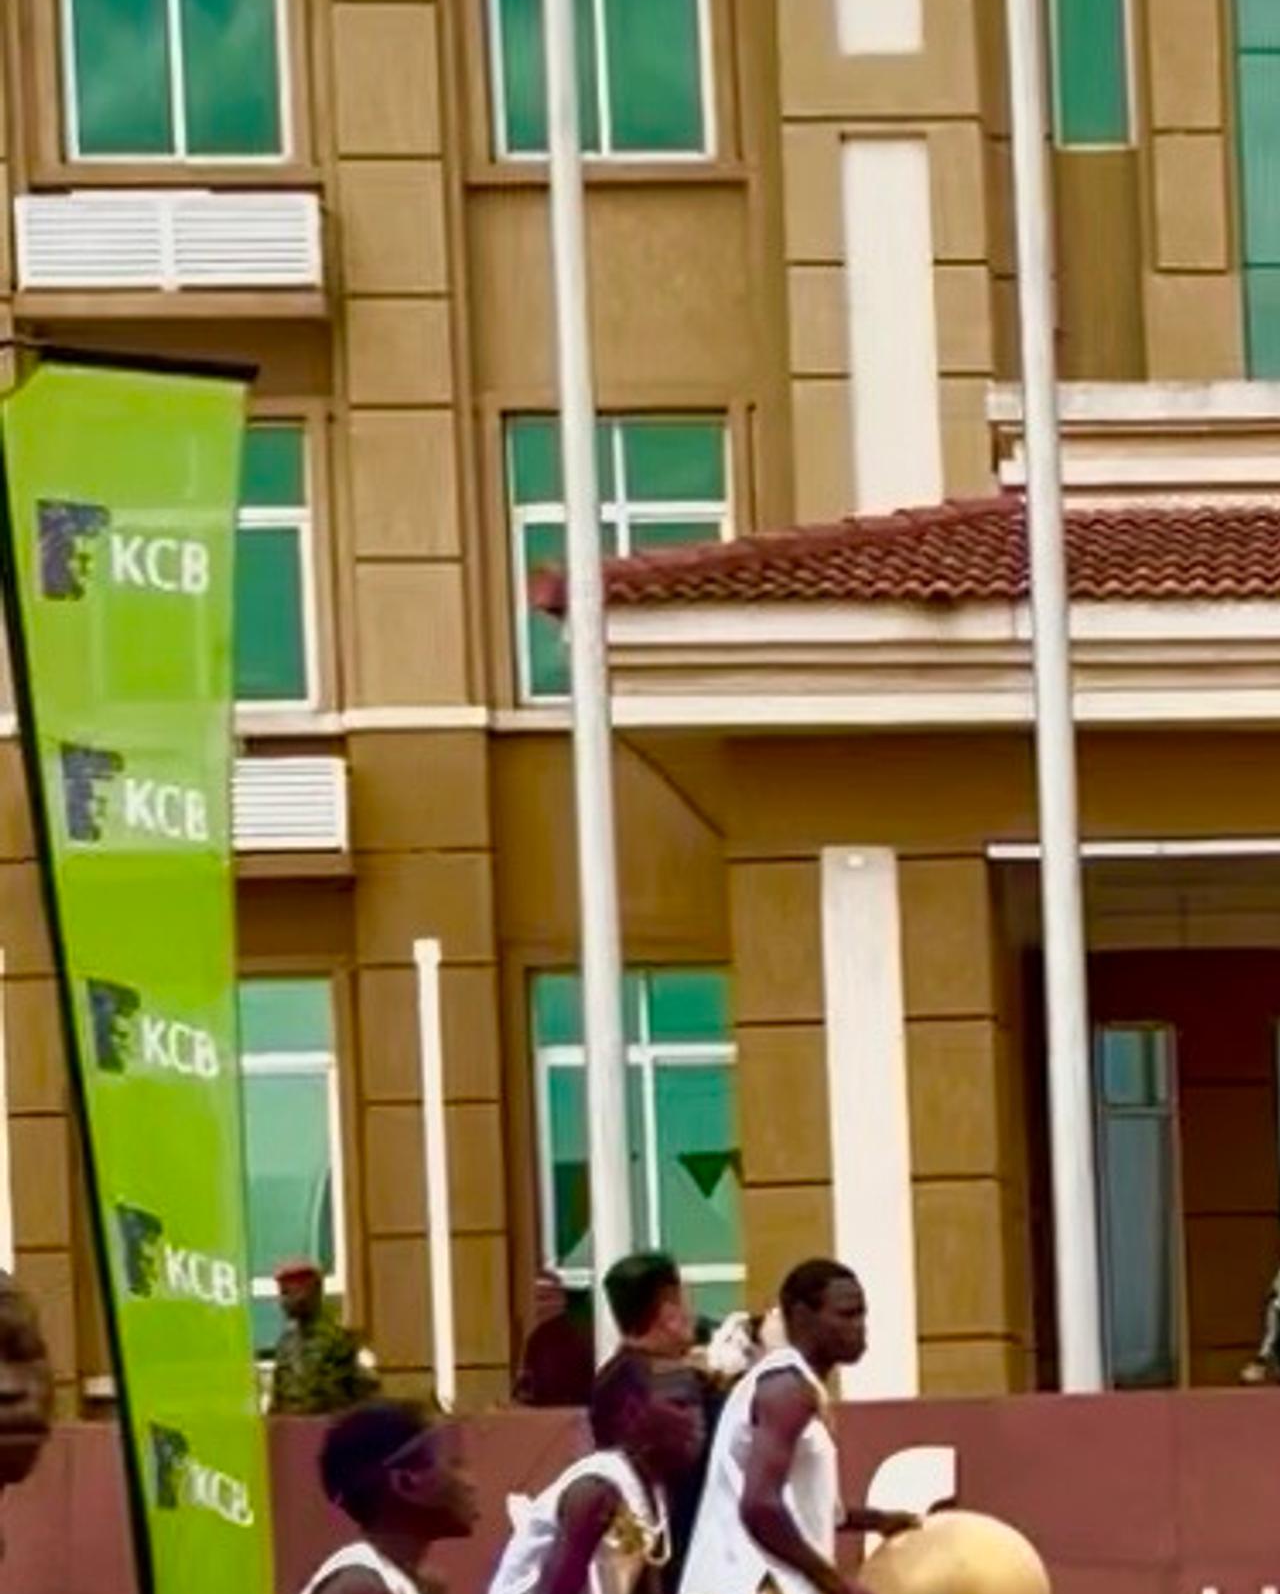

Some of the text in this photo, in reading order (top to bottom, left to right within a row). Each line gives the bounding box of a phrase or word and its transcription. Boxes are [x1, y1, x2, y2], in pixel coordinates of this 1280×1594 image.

[110, 534, 209, 594] KCB
[122, 778, 209, 842] KCB
[141, 1017, 221, 1078] KCB
[165, 1248, 240, 1307] KCB
